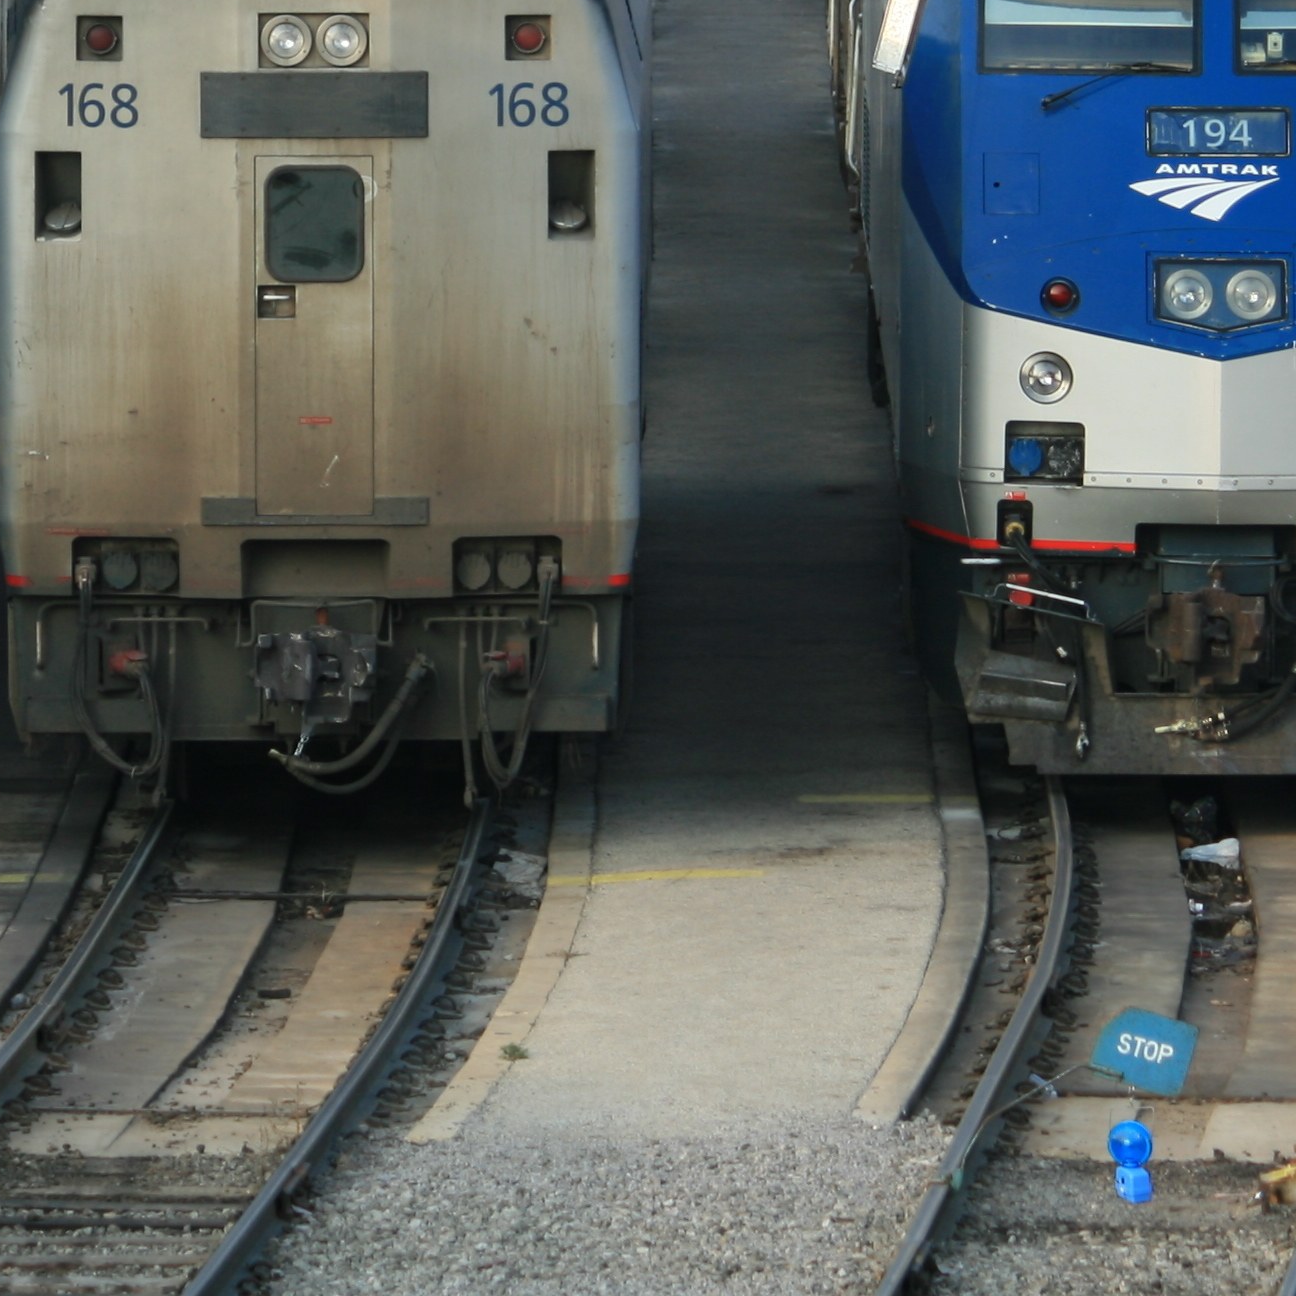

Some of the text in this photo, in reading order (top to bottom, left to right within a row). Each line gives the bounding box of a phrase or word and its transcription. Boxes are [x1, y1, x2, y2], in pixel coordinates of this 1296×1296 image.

[58, 82, 140, 129] 168
[488, 81, 570, 128] 168
[1182, 118, 1253, 148] 194
[1155, 163, 1279, 176] AMTRAK
[1117, 1033, 1174, 1064] STOP
